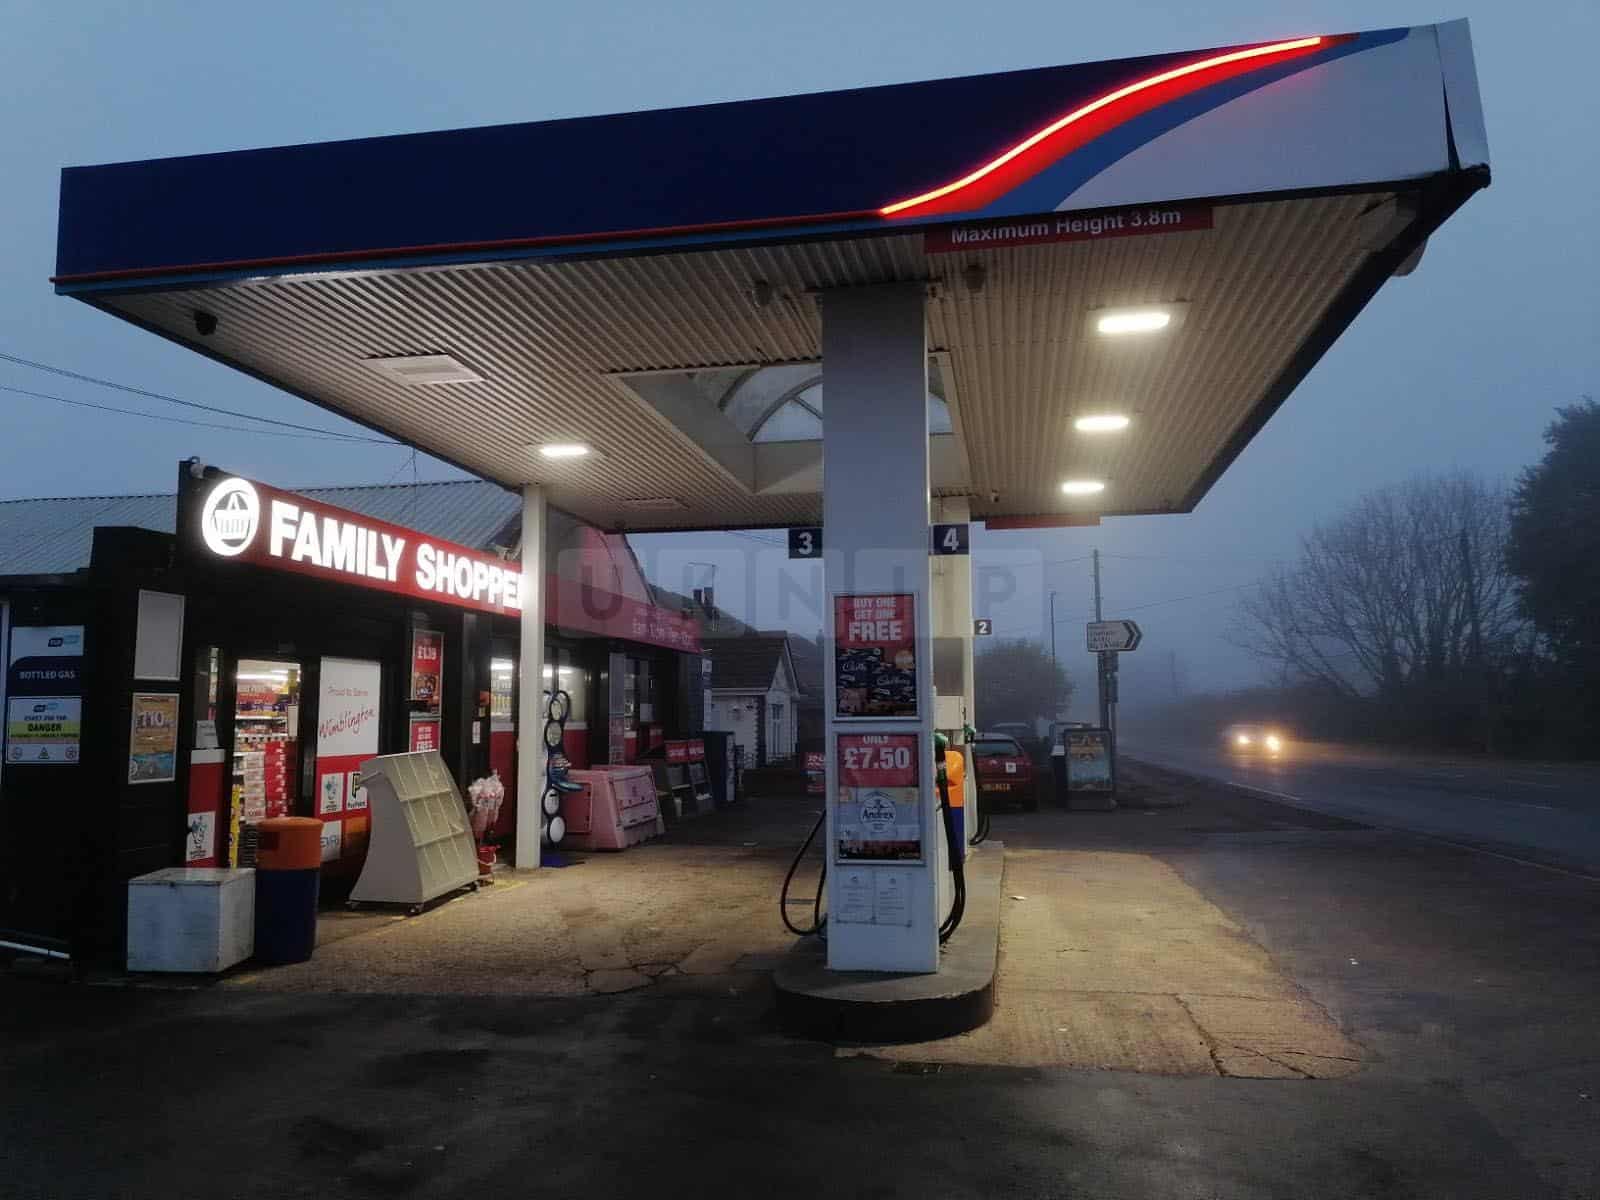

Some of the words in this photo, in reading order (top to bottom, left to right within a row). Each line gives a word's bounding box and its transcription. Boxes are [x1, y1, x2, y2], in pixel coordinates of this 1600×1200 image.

[951, 222, 1049, 243] Maximum
[1056, 214, 1124, 234] Height
[1130, 211, 1182, 227] 3.8m
[797, 532, 814, 555] 3
[943, 527, 960, 551] 4
[269, 498, 406, 582] FAMILY
[415, 543, 523, 610] SHOPPE
[854, 597, 874, 608] BUY
[876, 597, 897, 608] ONE
[854, 609, 873, 620] GET
[848, 620, 903, 641] FREE
[978, 621, 988, 634] 2
[20, 671, 57, 680] BOTTLED
[58, 671, 75, 680] GAS
[27, 723, 62, 732] DANGER
[844, 747, 910, 769] £7.50
